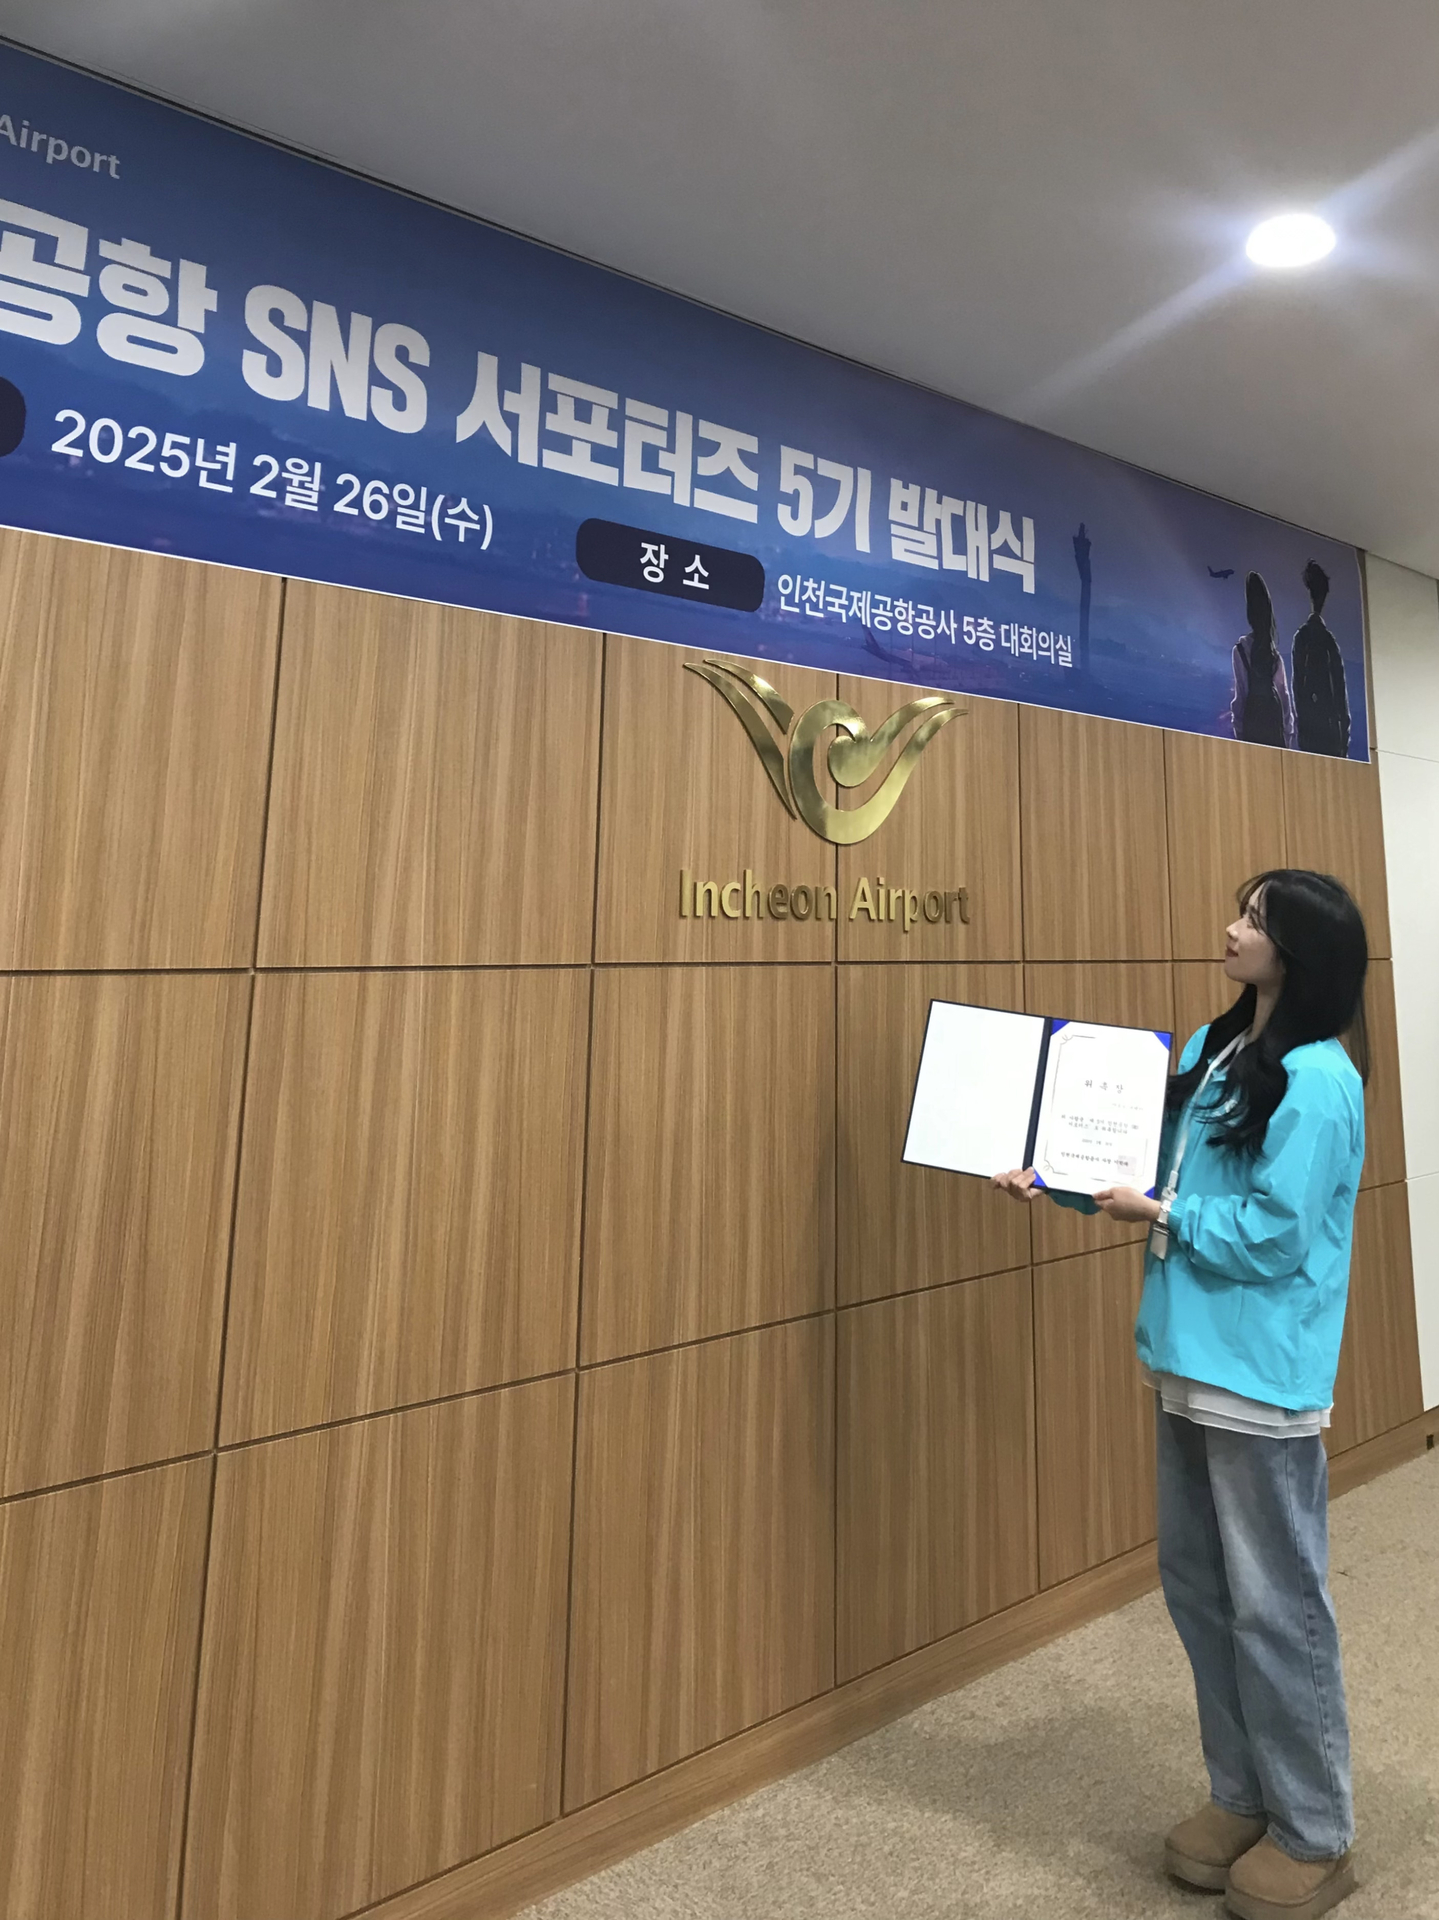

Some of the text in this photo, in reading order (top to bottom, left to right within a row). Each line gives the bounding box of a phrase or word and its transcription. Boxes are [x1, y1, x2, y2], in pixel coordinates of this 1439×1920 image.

[0, 114, 120, 179] Airport
[0, 199, 1036, 595] 공항 SNS 서포터즈 5기 발대식
[51, 409, 494, 550] 2025년 2월 26일(수)
[777, 574, 1074, 668] 인천국제공항공사 5층 대회의실
[679, 868, 970, 934] Incheon Airport
